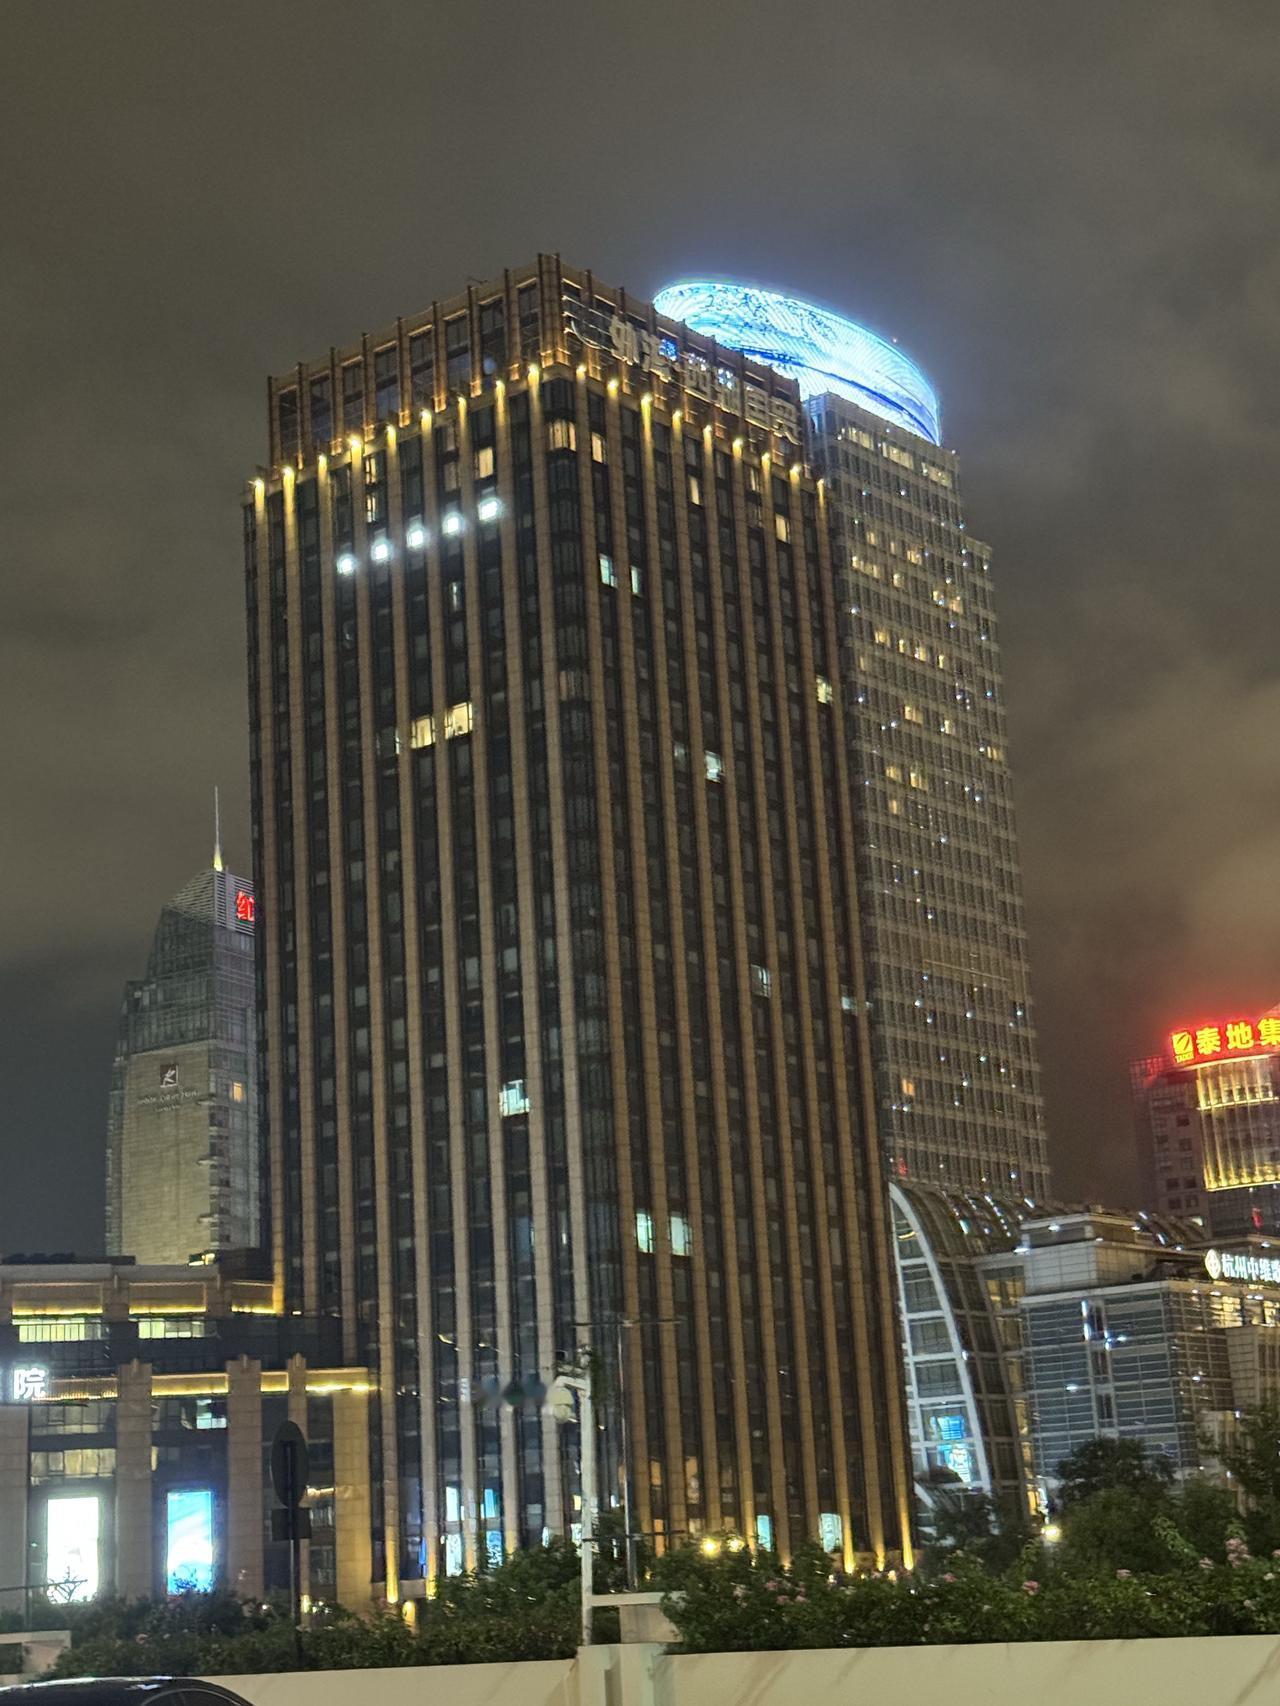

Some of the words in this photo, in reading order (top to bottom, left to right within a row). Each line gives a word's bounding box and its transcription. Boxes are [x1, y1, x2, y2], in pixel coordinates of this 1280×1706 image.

[1196, 1018, 1280, 1055] 泰地集
[13, 1367, 46, 1400] 院
